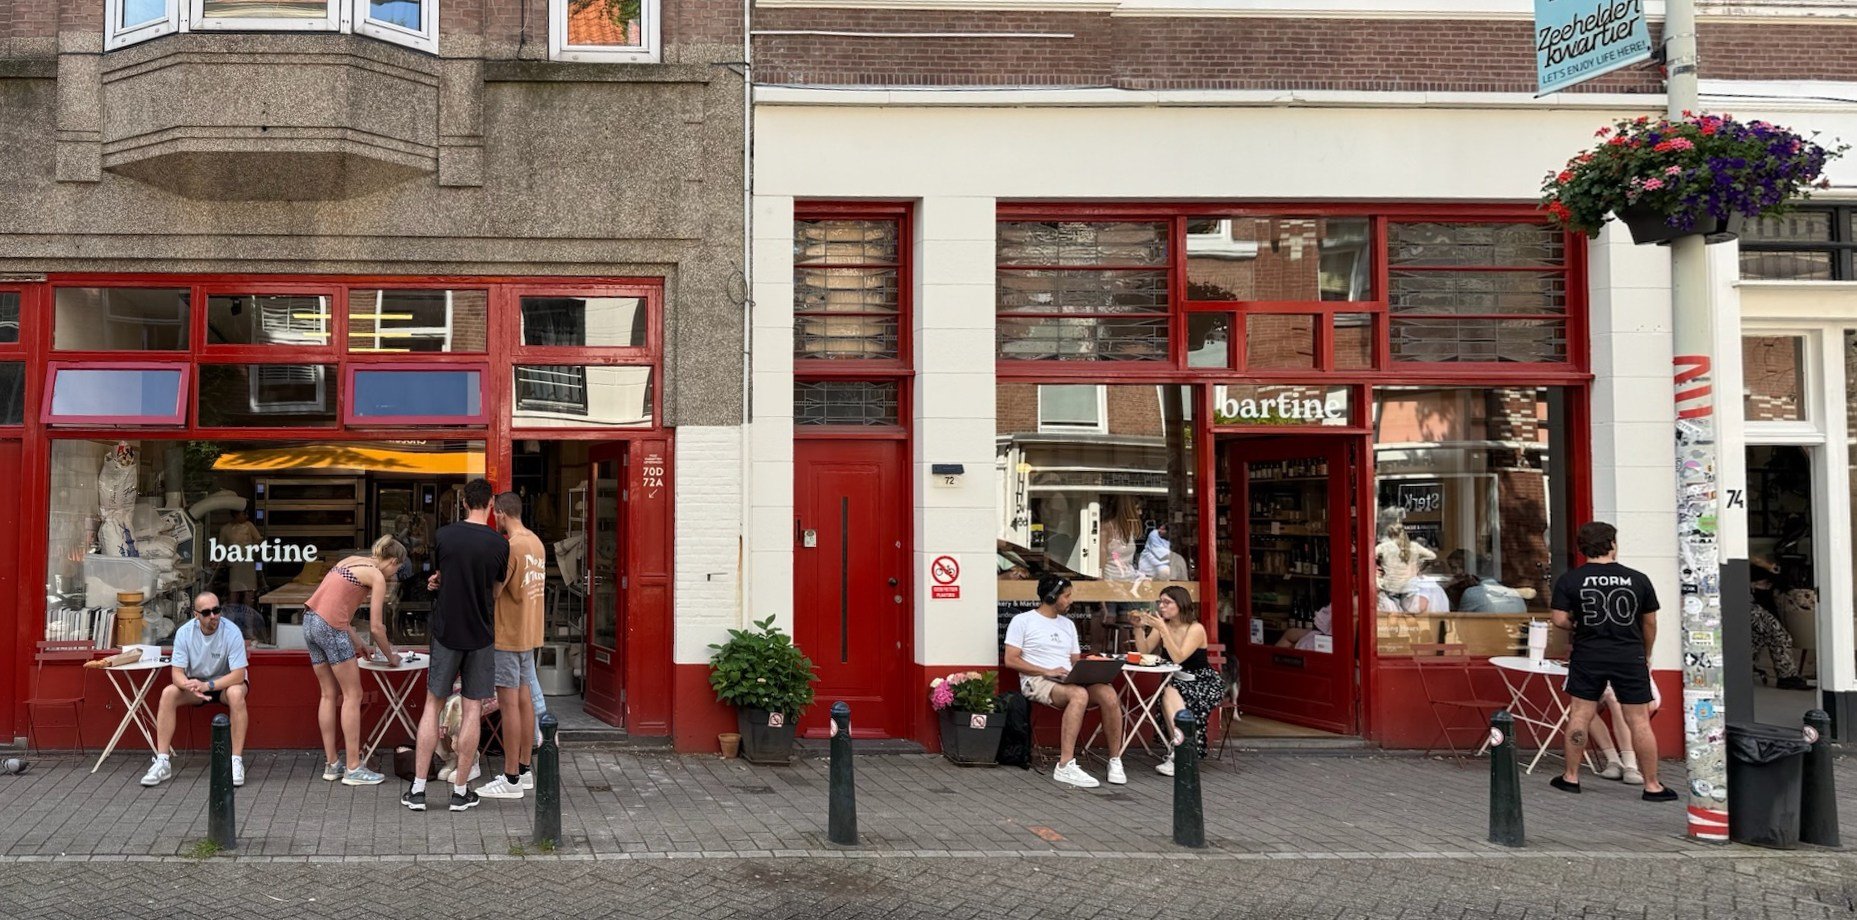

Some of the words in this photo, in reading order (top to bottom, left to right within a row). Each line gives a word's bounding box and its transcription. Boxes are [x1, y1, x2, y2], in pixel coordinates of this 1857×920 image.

[1538, 0, 1641, 52] Zeehelden
[1544, 16, 1640, 69] kwartier
[1543, 71, 1566, 84] LET'S
[1567, 60, 1595, 76] ENJOY
[1596, 51, 1617, 65] LIFE
[1617, 41, 1646, 57] HERE!
[1219, 391, 1342, 419] bartine
[643, 467, 664, 476] 70D
[643, 477, 664, 487] 72A
[944, 476, 955, 485] 72
[1726, 489, 1744, 509] 74
[208, 537, 318, 562] bartine
[1582, 576, 1632, 587] STORM
[1580, 587, 1639, 626] 30
